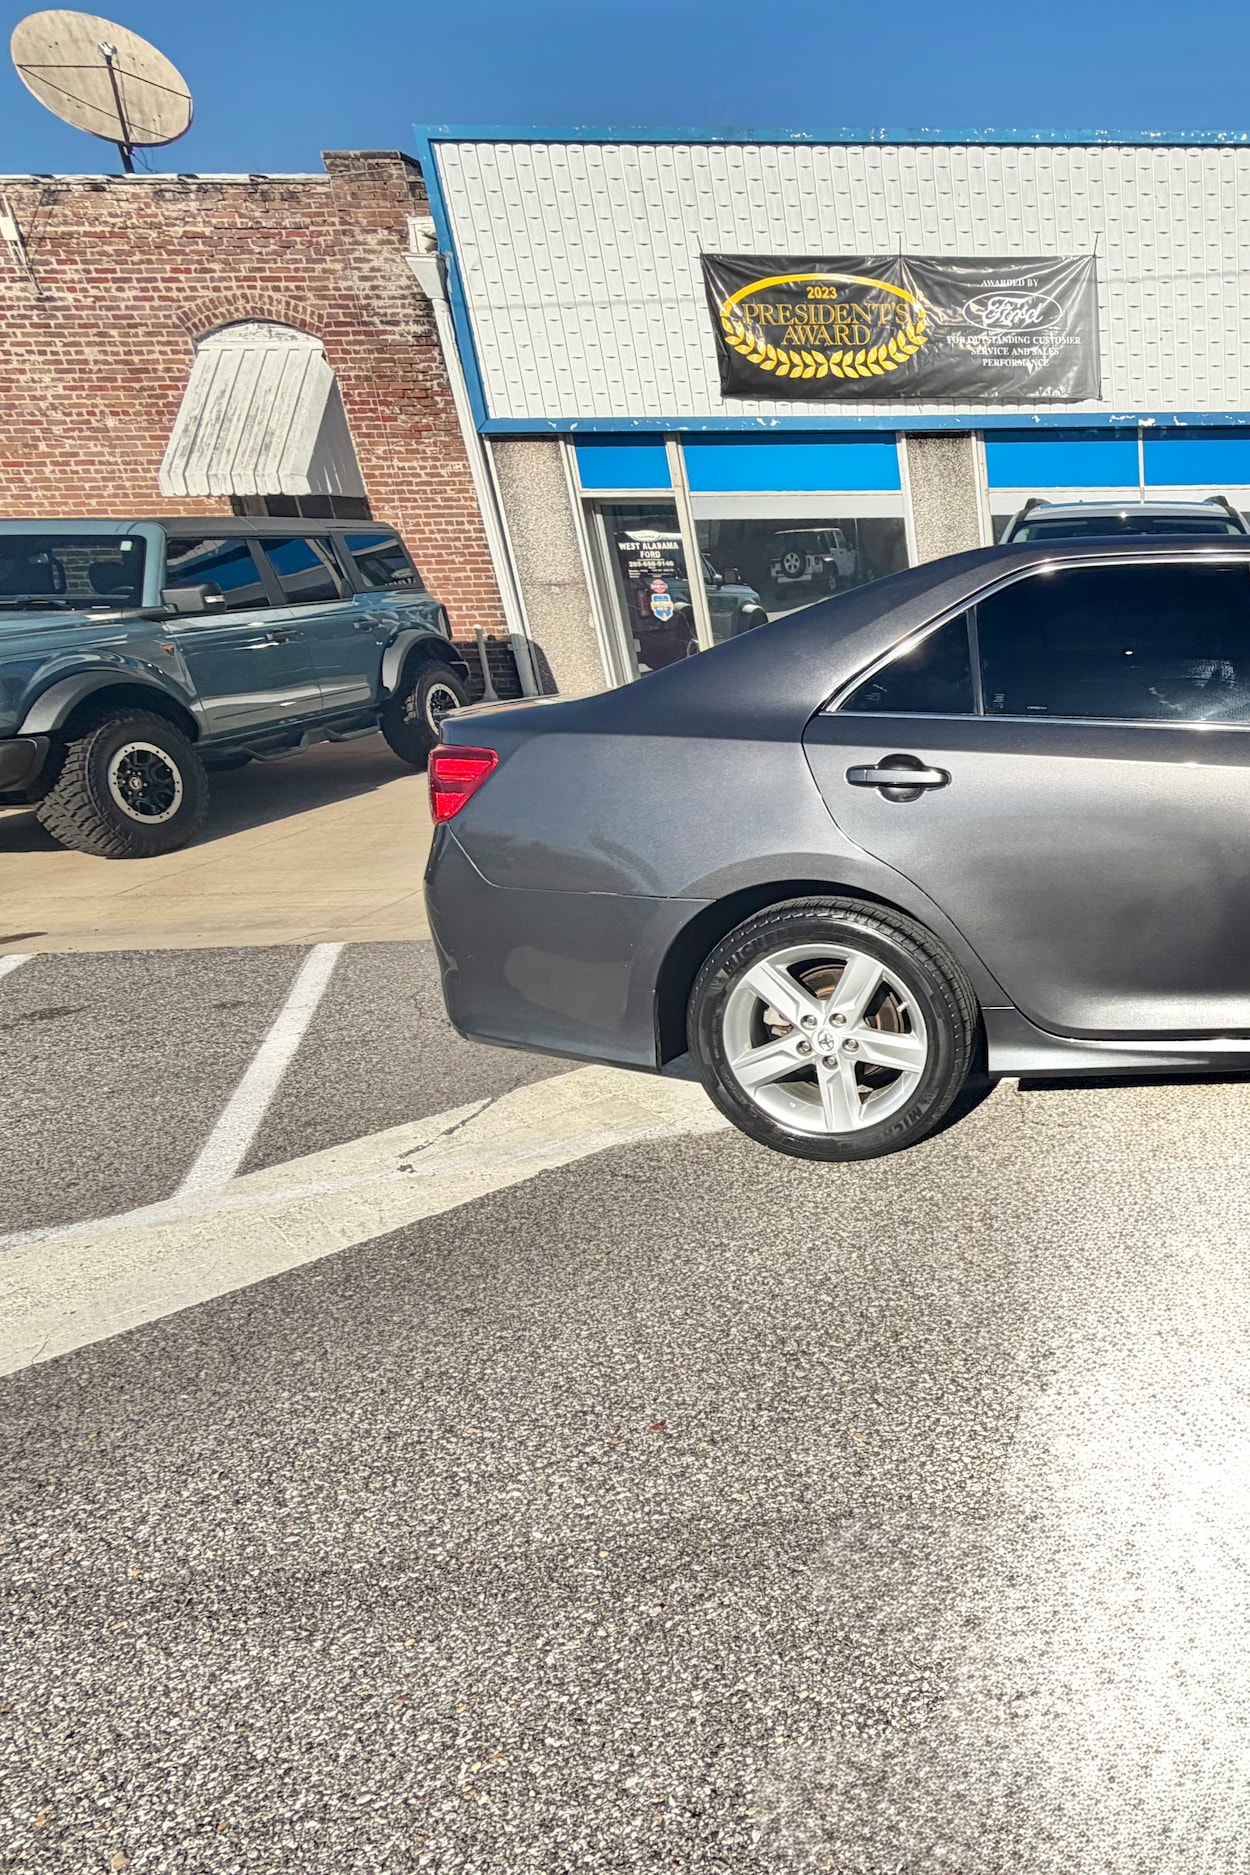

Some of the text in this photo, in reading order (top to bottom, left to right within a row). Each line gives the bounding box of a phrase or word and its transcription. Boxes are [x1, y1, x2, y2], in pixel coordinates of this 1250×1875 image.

[981, 278, 1040, 288] AWARDED BY
[805, 286, 839, 300] 2023
[741, 302, 910, 326] PRESIDENT'S
[981, 296, 1044, 328] Ford
[781, 324, 872, 346] AWARD
[946, 335, 1082, 345] FOR OUTSTANDING CUSTOMER
[971, 347, 1060, 356] SERVICE AND SALES
[982, 358, 1050, 367] PERFORMANCE
[618, 541, 679, 550] WEST ALABAMA
[639, 550, 662, 559] FORD
